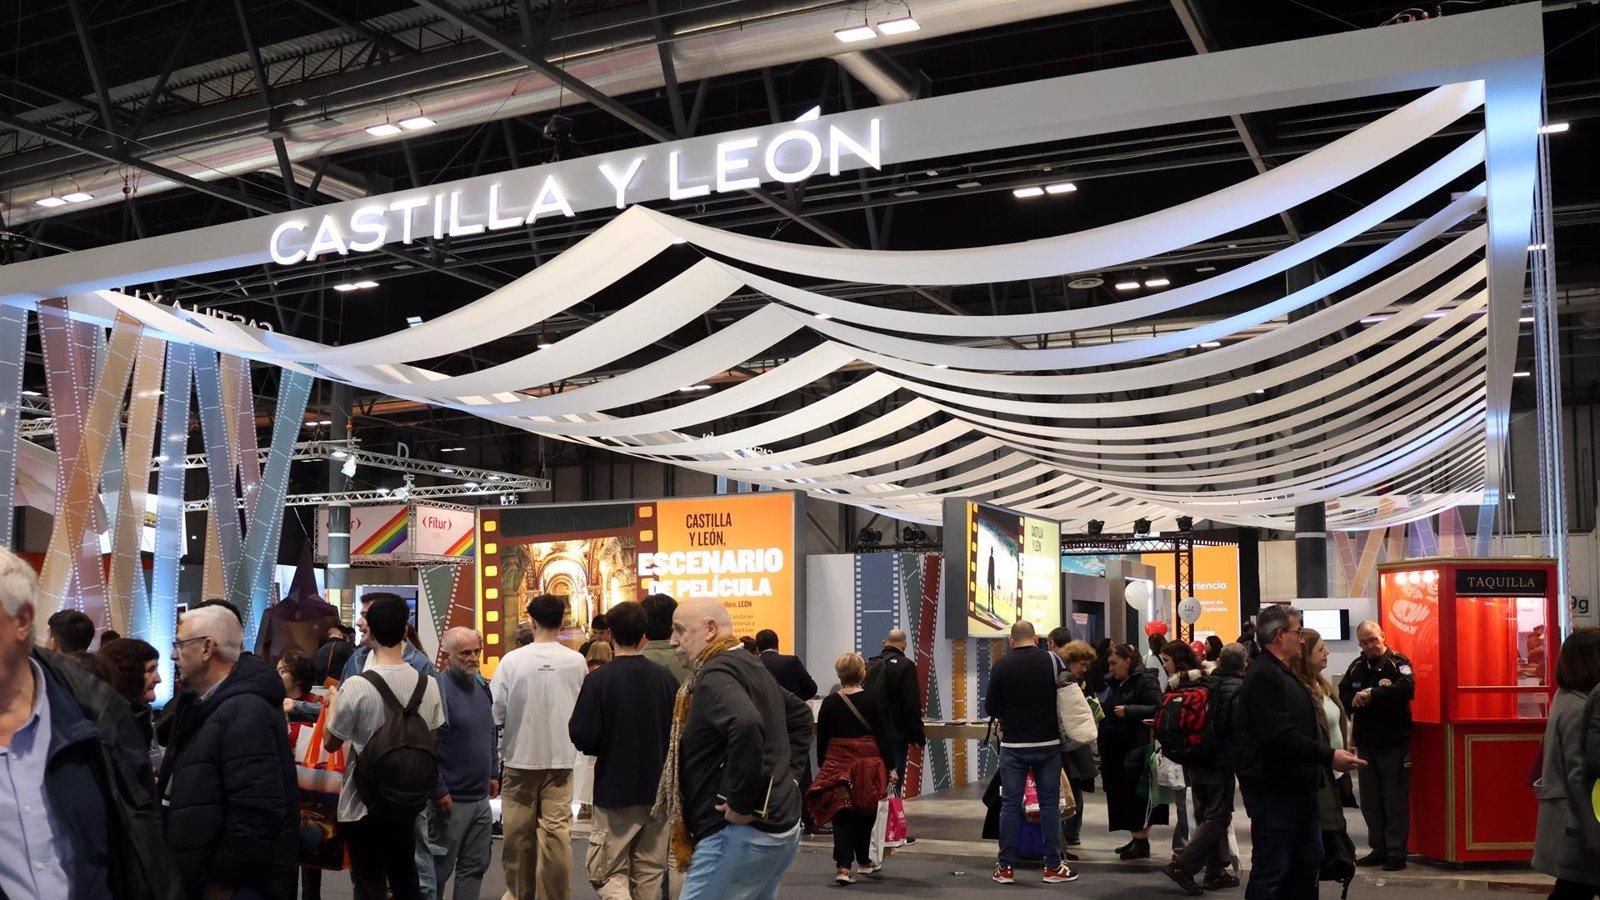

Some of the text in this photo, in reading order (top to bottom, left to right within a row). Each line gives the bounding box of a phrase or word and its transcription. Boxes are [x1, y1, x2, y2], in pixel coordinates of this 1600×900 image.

[269, 104, 882, 266] CASTILLA Y LEÓN
[428, 516, 447, 530] Fitur
[685, 512, 732, 529] CASTILLA
[689, 527, 726, 547] Y LEÓN,
[637, 547, 784, 576] ESCENARIO
[648, 574, 773, 598] DE PELÍCULA
[1466, 575, 1536, 590] TAQUILLA
